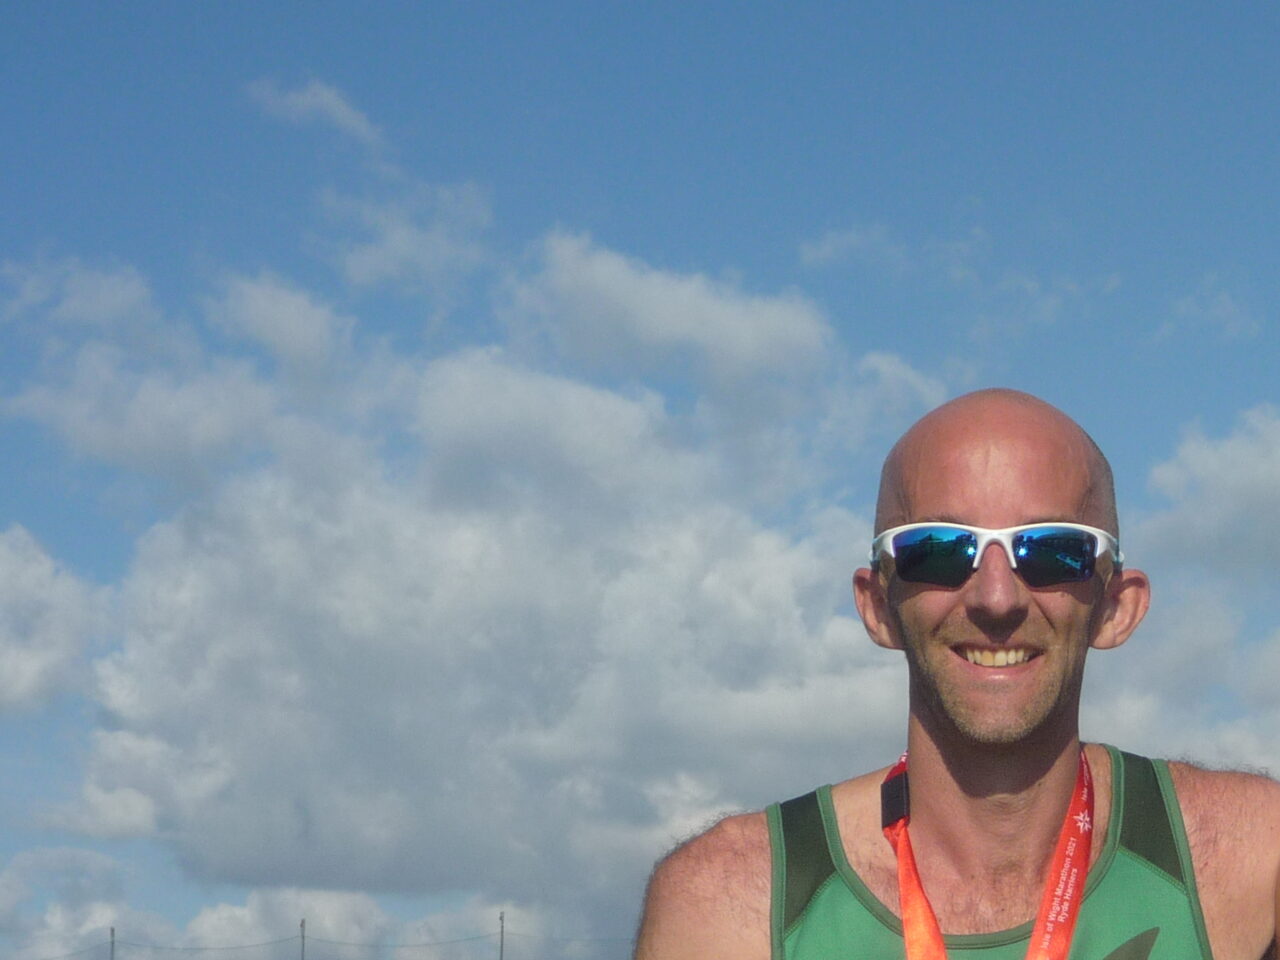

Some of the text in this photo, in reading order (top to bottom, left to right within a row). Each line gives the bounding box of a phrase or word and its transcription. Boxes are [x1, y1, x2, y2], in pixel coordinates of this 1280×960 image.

[1040, 838, 1076, 949] Isle of Wight Marathon 2021
[1057, 868, 1078, 922] Ryde Harriers
